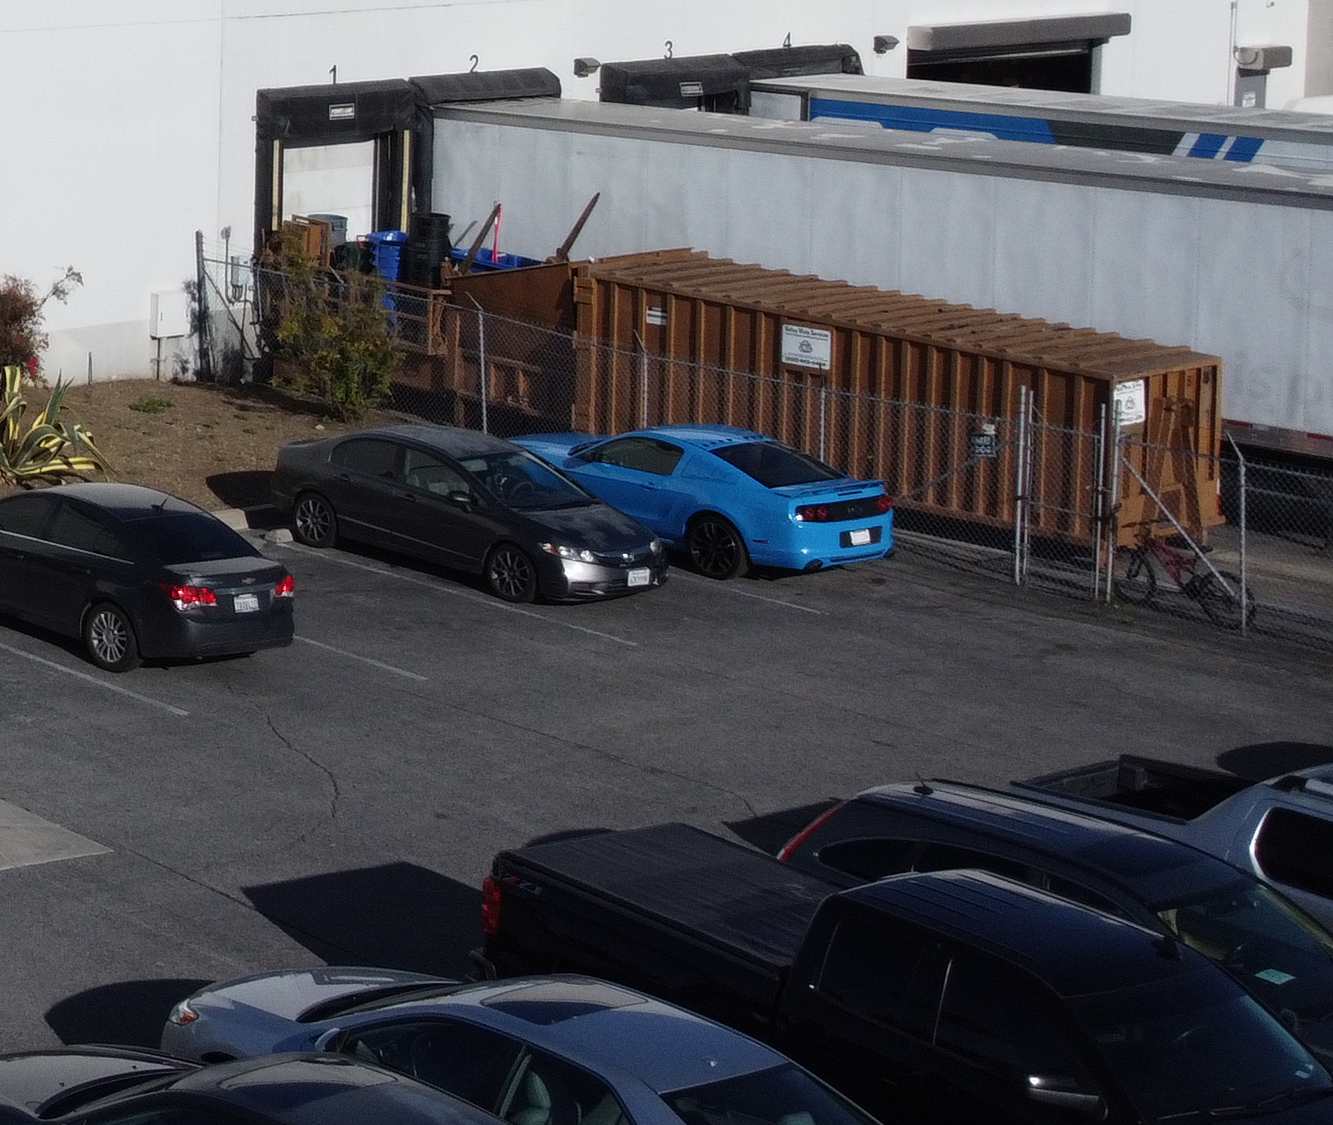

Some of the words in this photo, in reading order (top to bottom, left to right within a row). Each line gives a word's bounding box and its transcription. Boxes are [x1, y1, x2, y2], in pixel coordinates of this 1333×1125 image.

[783, 31, 792, 48] 4
[664, 40, 673, 59] 3
[469, 54, 479, 73] 2
[329, 64, 337, 84] 1
